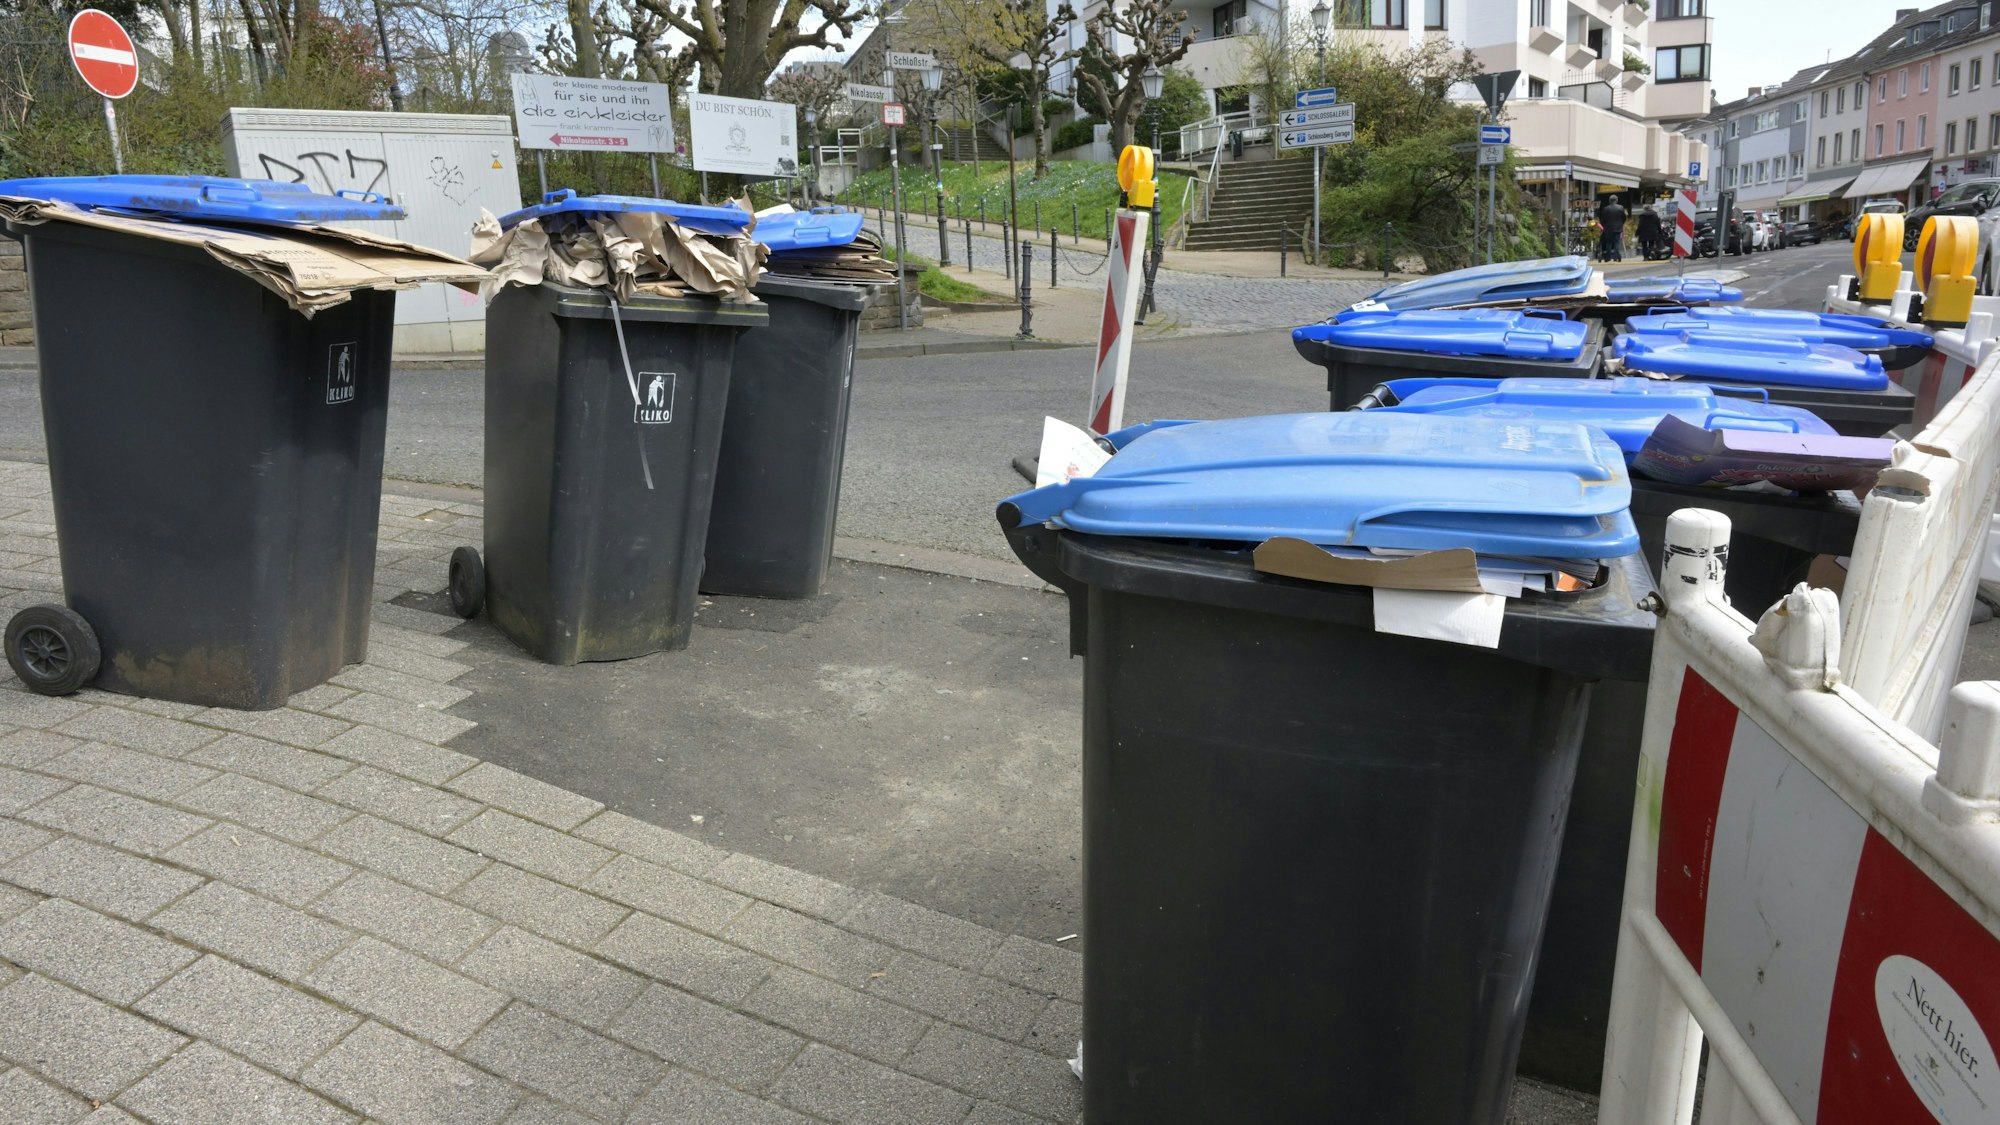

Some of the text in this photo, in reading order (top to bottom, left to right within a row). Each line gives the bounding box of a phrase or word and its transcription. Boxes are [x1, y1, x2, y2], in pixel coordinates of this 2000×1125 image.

[893, 55, 931, 67] Schloßstr.
[571, 81, 599, 90] kleine
[602, 84, 648, 93] mode-treff
[554, 91, 650, 105] für sie und ihn
[522, 105, 667, 122] die einkleider
[695, 101, 774, 119] DU BIST SCHÖN.
[1307, 109, 1350, 121] SCHLOSSGALERIE
[584, 124, 615, 132] kramm
[1335, 130, 1351, 138] Garage
[560, 136, 607, 146] Nikolausstr.
[619, 138, 625, 146] 5
[329, 385, 353, 401] KLIKO
[1756, 463, 1802, 473] Unicorn
[1906, 975, 1944, 1033] Nett
[1943, 1020, 1979, 1079] hier.
